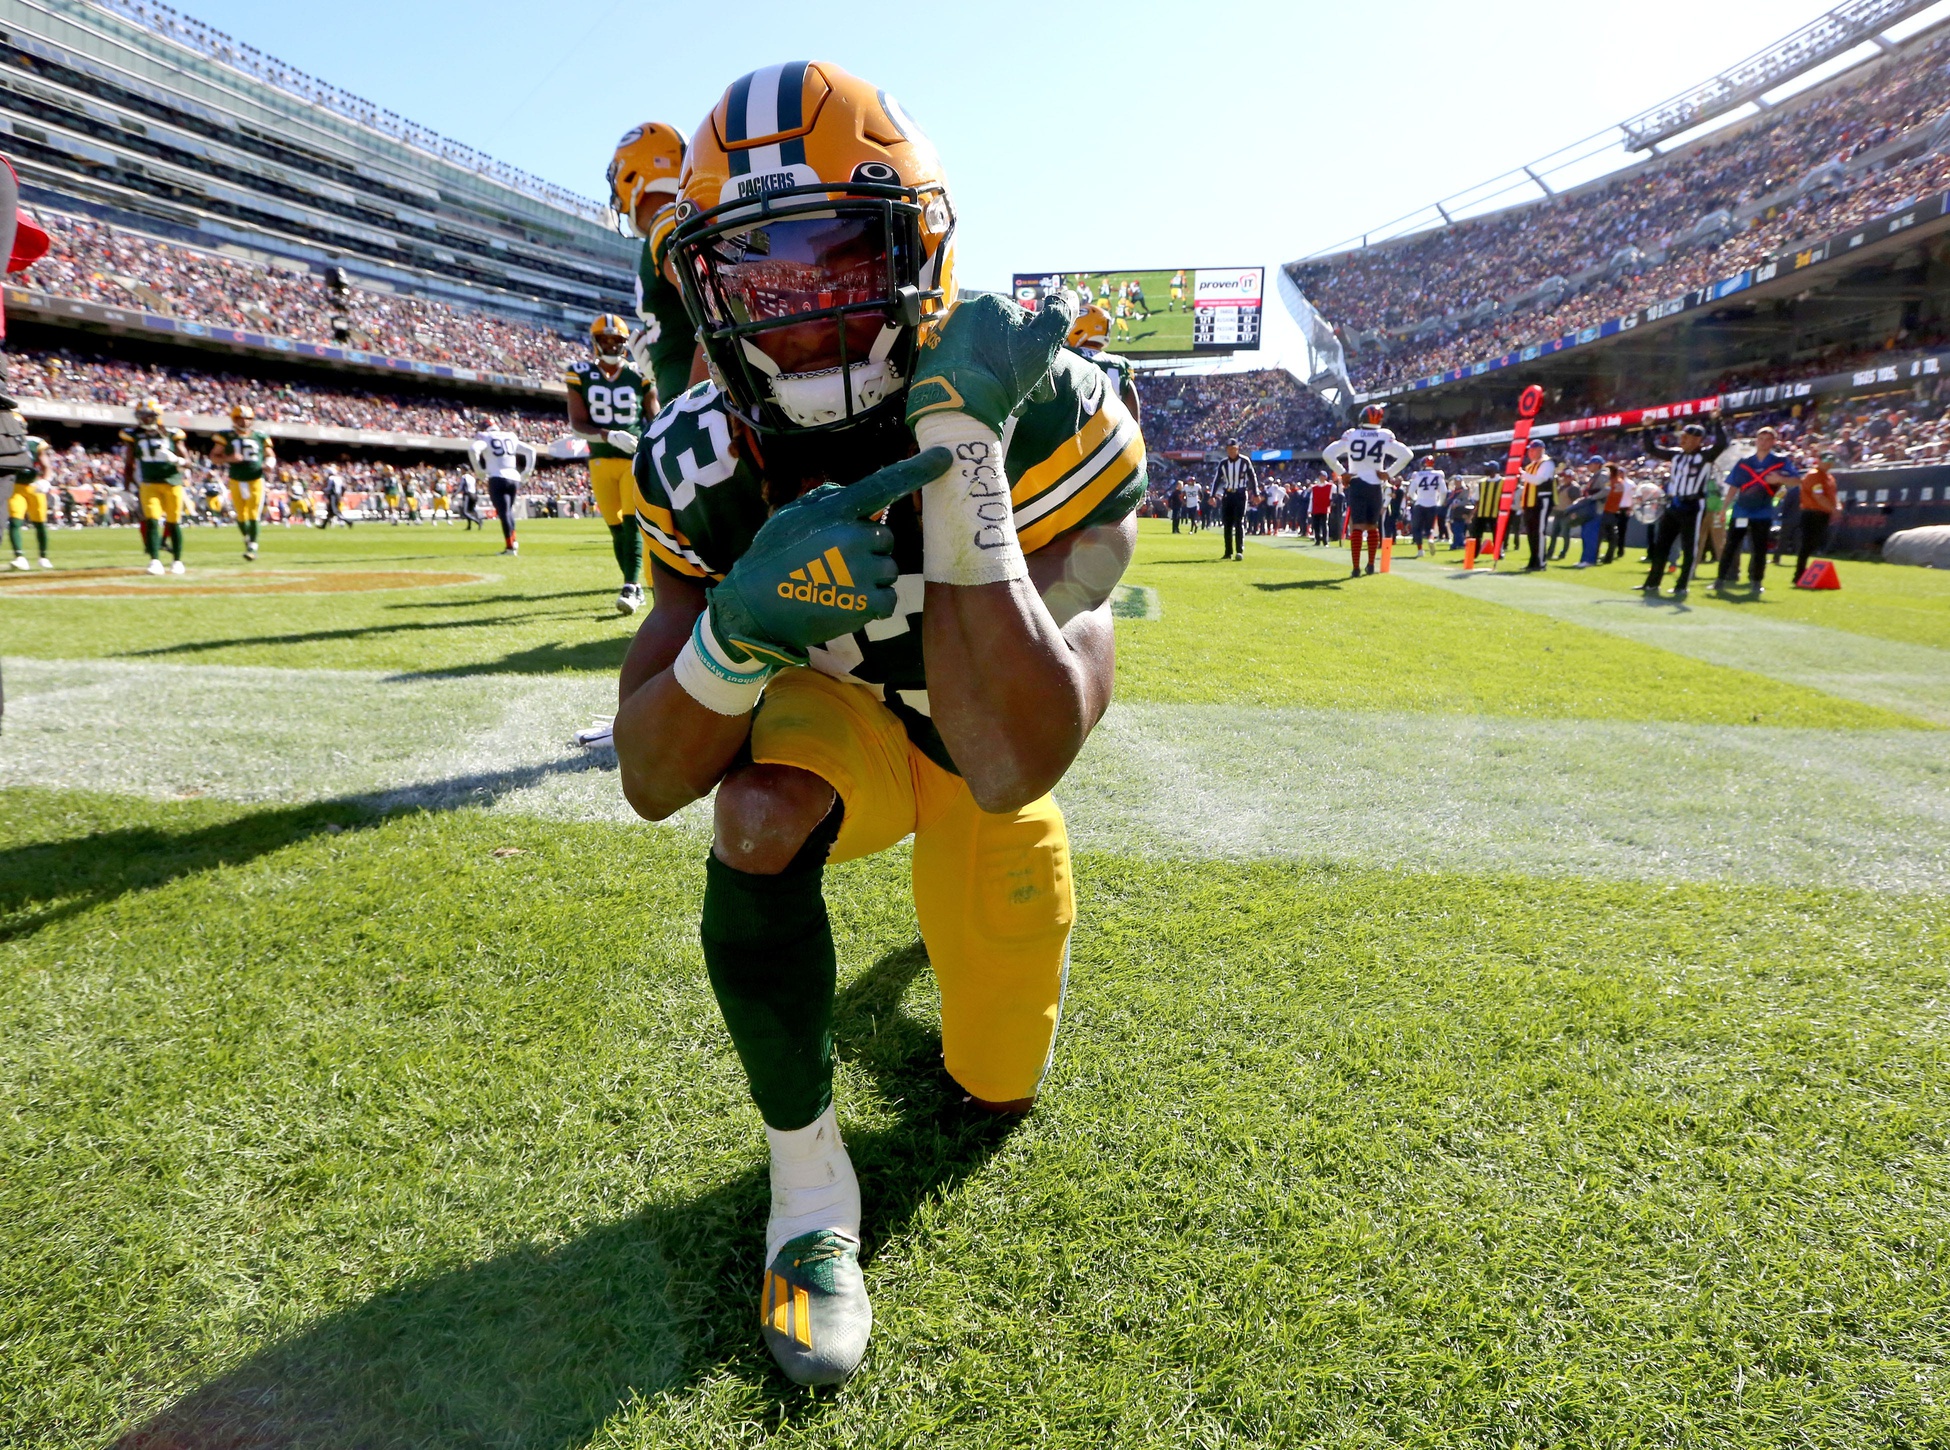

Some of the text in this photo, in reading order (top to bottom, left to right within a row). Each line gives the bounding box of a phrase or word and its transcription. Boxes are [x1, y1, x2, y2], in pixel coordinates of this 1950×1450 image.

[737, 172, 796, 198] PACKERS
[1199, 278, 1253, 291] proven IT
[588, 385, 637, 424] 89
[231, 438, 259, 462] 12
[490, 438, 515, 457] 90
[1350, 439, 1385, 463] 94
[1418, 476, 1440, 490] 44
[1801, 563, 1825, 586] G
[777, 581, 868, 611] adidas
